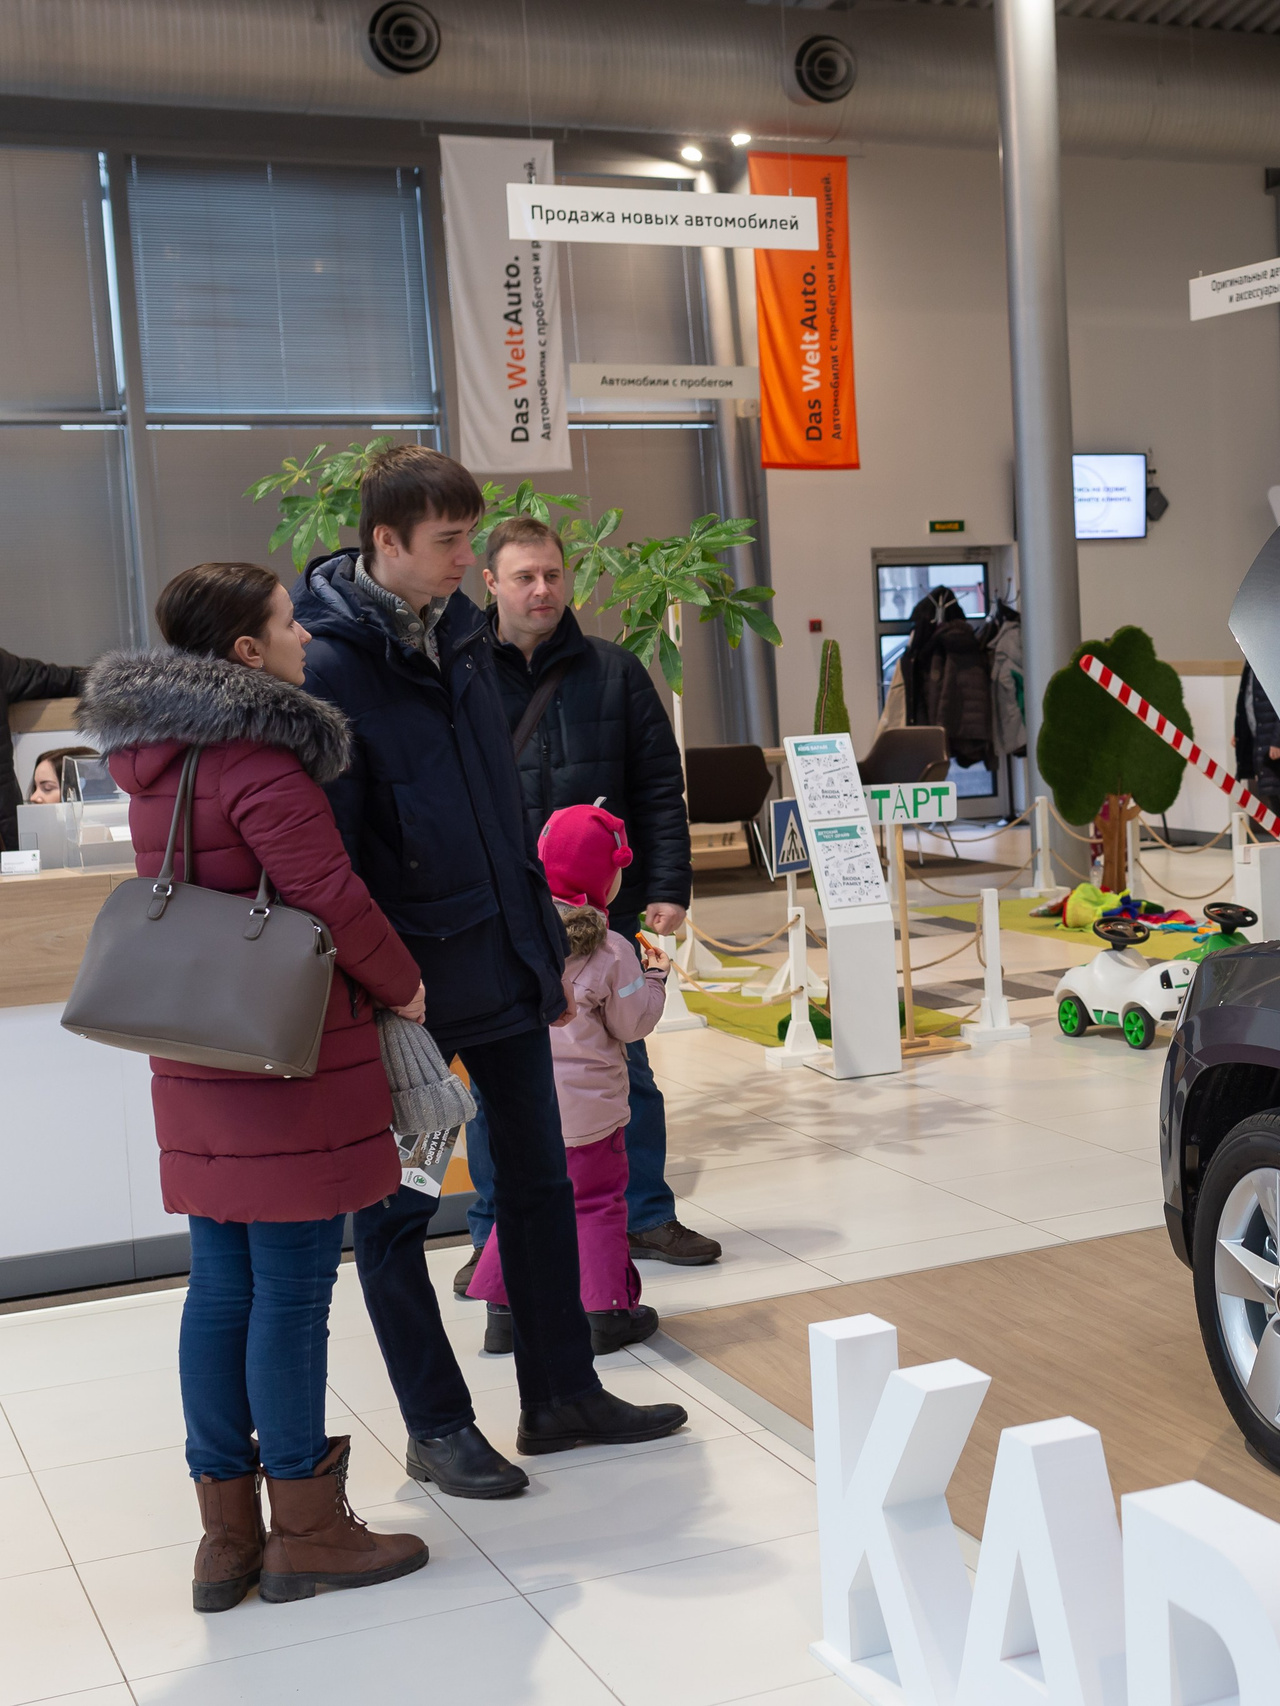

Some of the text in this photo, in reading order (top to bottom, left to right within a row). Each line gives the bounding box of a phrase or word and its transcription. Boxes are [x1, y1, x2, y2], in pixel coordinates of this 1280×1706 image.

[531, 205, 799, 231] Продажа новых автомобилей
[821, 173, 836, 258] репутацией.
[532, 265, 548, 335] пробегом
[1211, 270, 1268, 293] Оригинальные
[1235, 284, 1280, 302] аксессуары
[826, 274, 839, 341] пробегом
[537, 351, 551, 441] Автомобили
[601, 375, 733, 388] Автомобили с пробегом
[830, 355, 841, 440] Автомобили
[511, 397, 529, 442] Das
[805, 398, 822, 441] Das
[863, 787, 949, 820] ТАРТ
